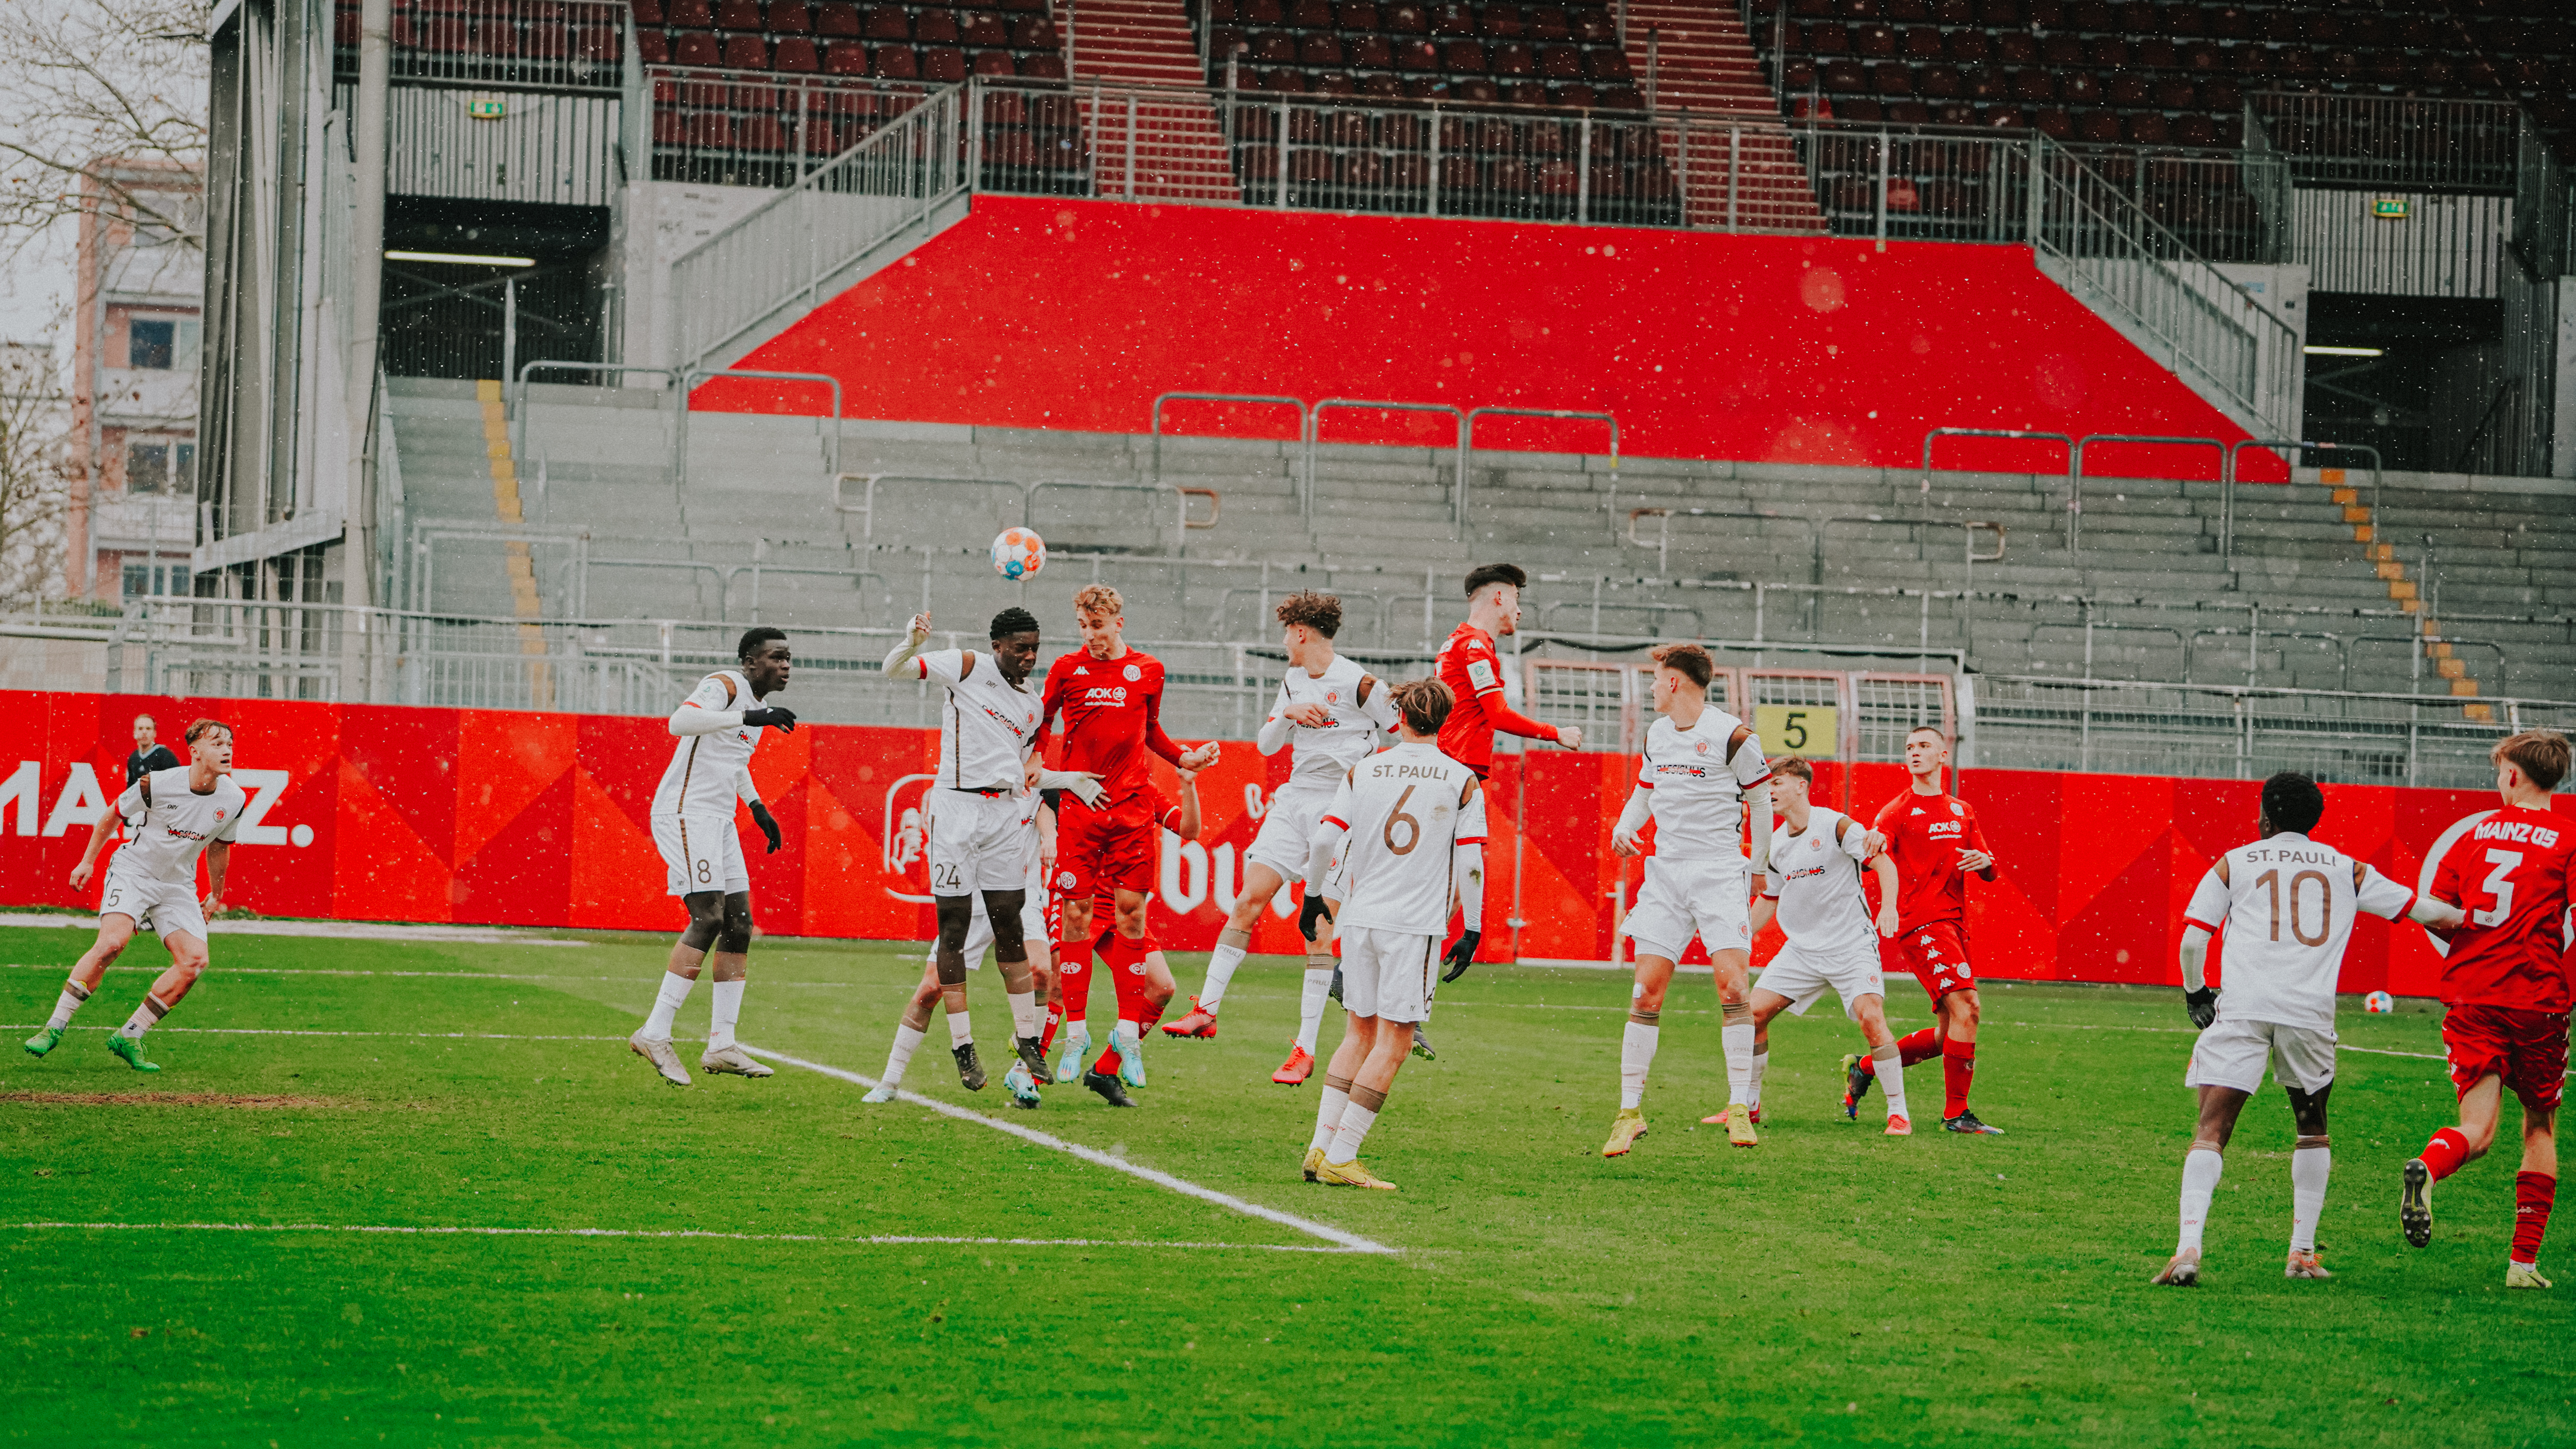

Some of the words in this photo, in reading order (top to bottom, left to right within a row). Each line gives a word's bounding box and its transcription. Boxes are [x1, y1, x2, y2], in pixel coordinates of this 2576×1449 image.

[1085, 688, 1112, 698] AOK
[1784, 712, 1807, 749] 5
[1372, 765, 1394, 778] ST.
[1398, 765, 1448, 781] PAULI
[1384, 785, 1420, 856] 6
[1928, 822, 1951, 833] AOK
[2474, 822, 2532, 843] MAINZ
[2530, 826, 2559, 849] 05
[2247, 849, 2273, 863] ST.
[2279, 850, 2336, 867] PAULI
[697, 859, 712, 884] 8
[935, 863, 961, 889] 24
[108, 889, 122, 906] 5
[2473, 848, 2523, 927] 3
[2255, 869, 2331, 947] 10
[1218, 945, 1241, 958] PAULI
